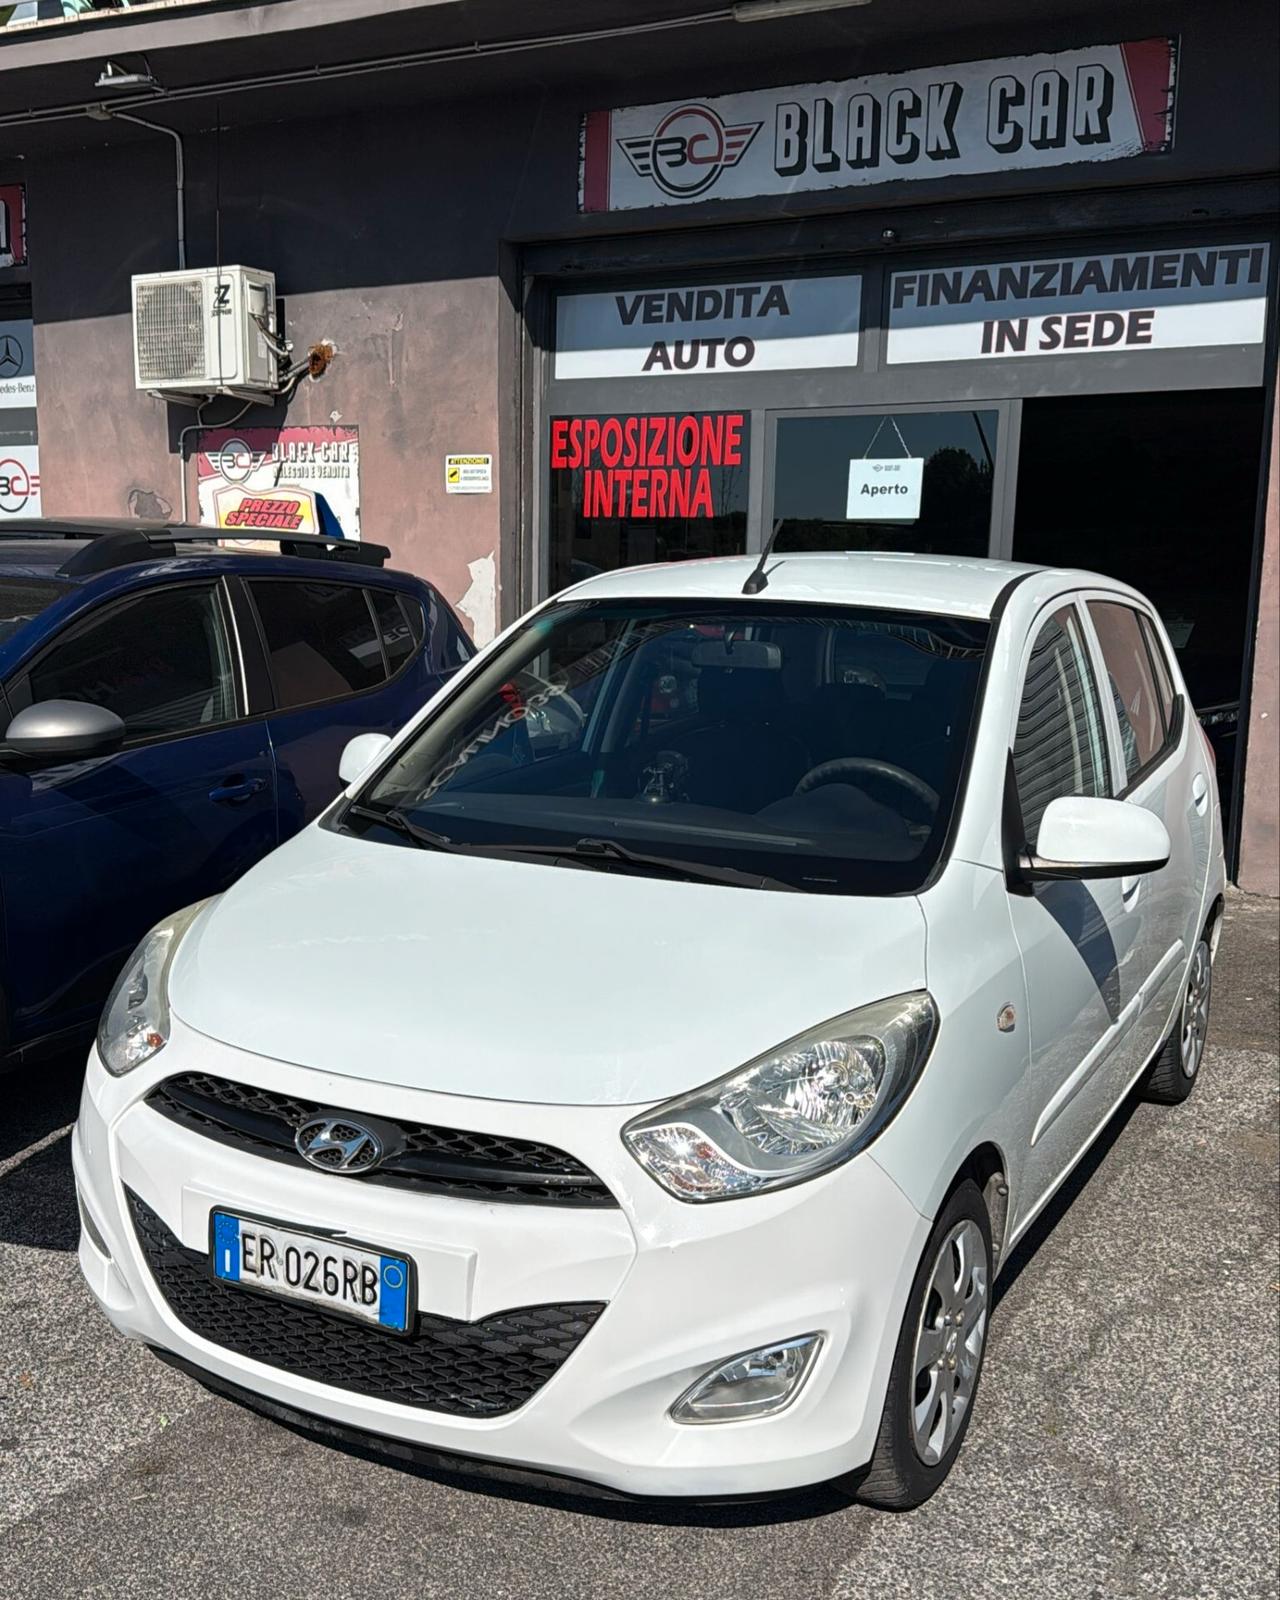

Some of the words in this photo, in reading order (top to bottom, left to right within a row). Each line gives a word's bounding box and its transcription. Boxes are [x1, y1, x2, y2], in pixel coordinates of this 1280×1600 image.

[774, 81, 963, 177] BLACK
[986, 64, 1115, 153] CAR
[892, 247, 1265, 309] FINANZIAMENTI
[615, 285, 791, 325] VENDITA
[980, 318, 1029, 355] IN
[1038, 310, 1156, 350] SEDE
[641, 335, 756, 372] AUTO
[272, 442, 316, 463] BLACK
[551, 414, 744, 469] ESPOSIZIONE
[318, 466, 351, 478] VENDITA
[860, 483, 909, 498] Aperto
[238, 497, 301, 515] PREZZO
[583, 468, 714, 518] INTERNA
[225, 511, 304, 530] SPECIALE
[224, 1248, 231, 1273] I
[241, 1233, 276, 1280] ER
[284, 1246, 379, 1306] 026RB
